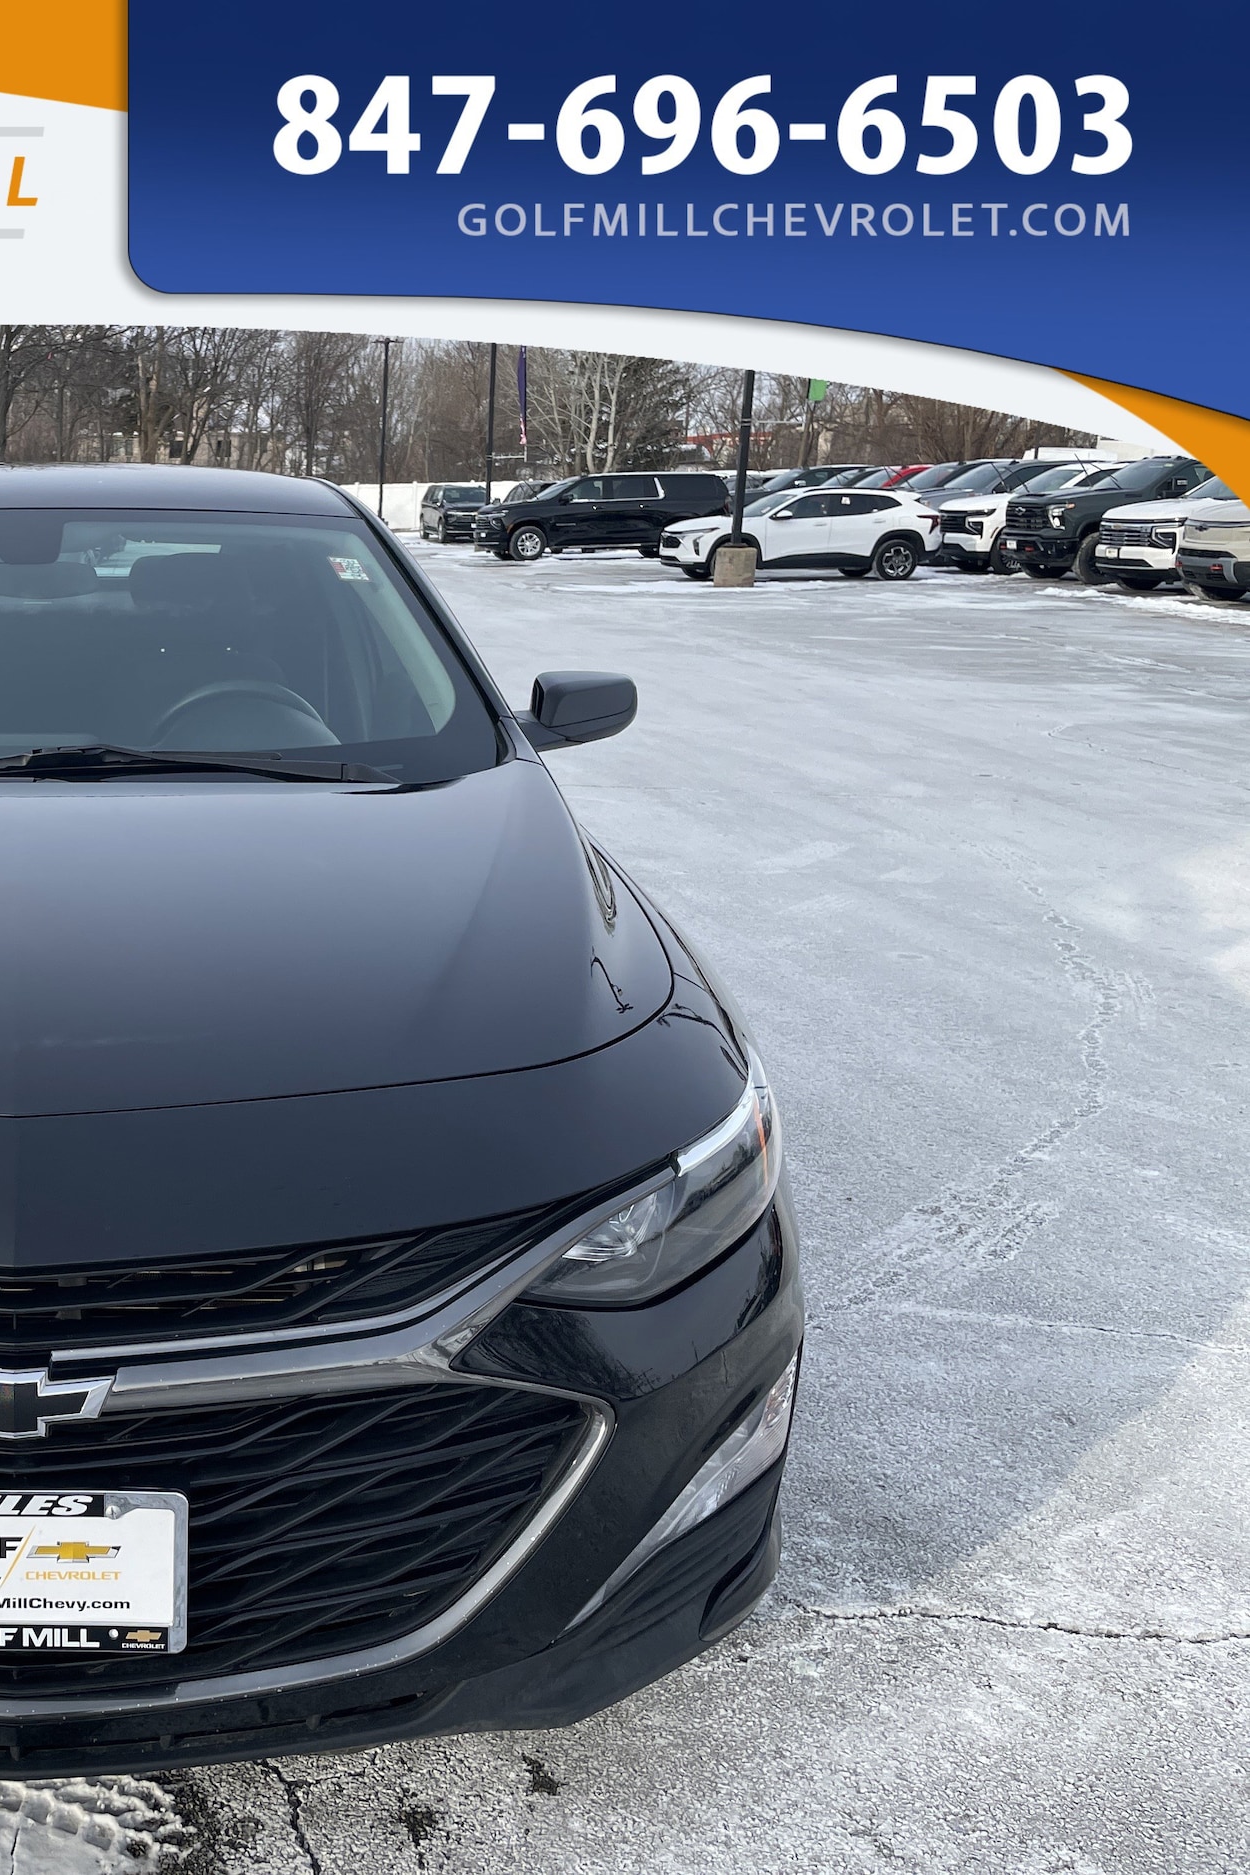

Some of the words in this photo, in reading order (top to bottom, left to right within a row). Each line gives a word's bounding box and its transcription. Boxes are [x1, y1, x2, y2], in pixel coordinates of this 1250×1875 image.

[25, 1570, 121, 1581] CHEVROLET
[22, 1627, 100, 1649] MILL
[121, 1642, 166, 1650] CHEVROLET
